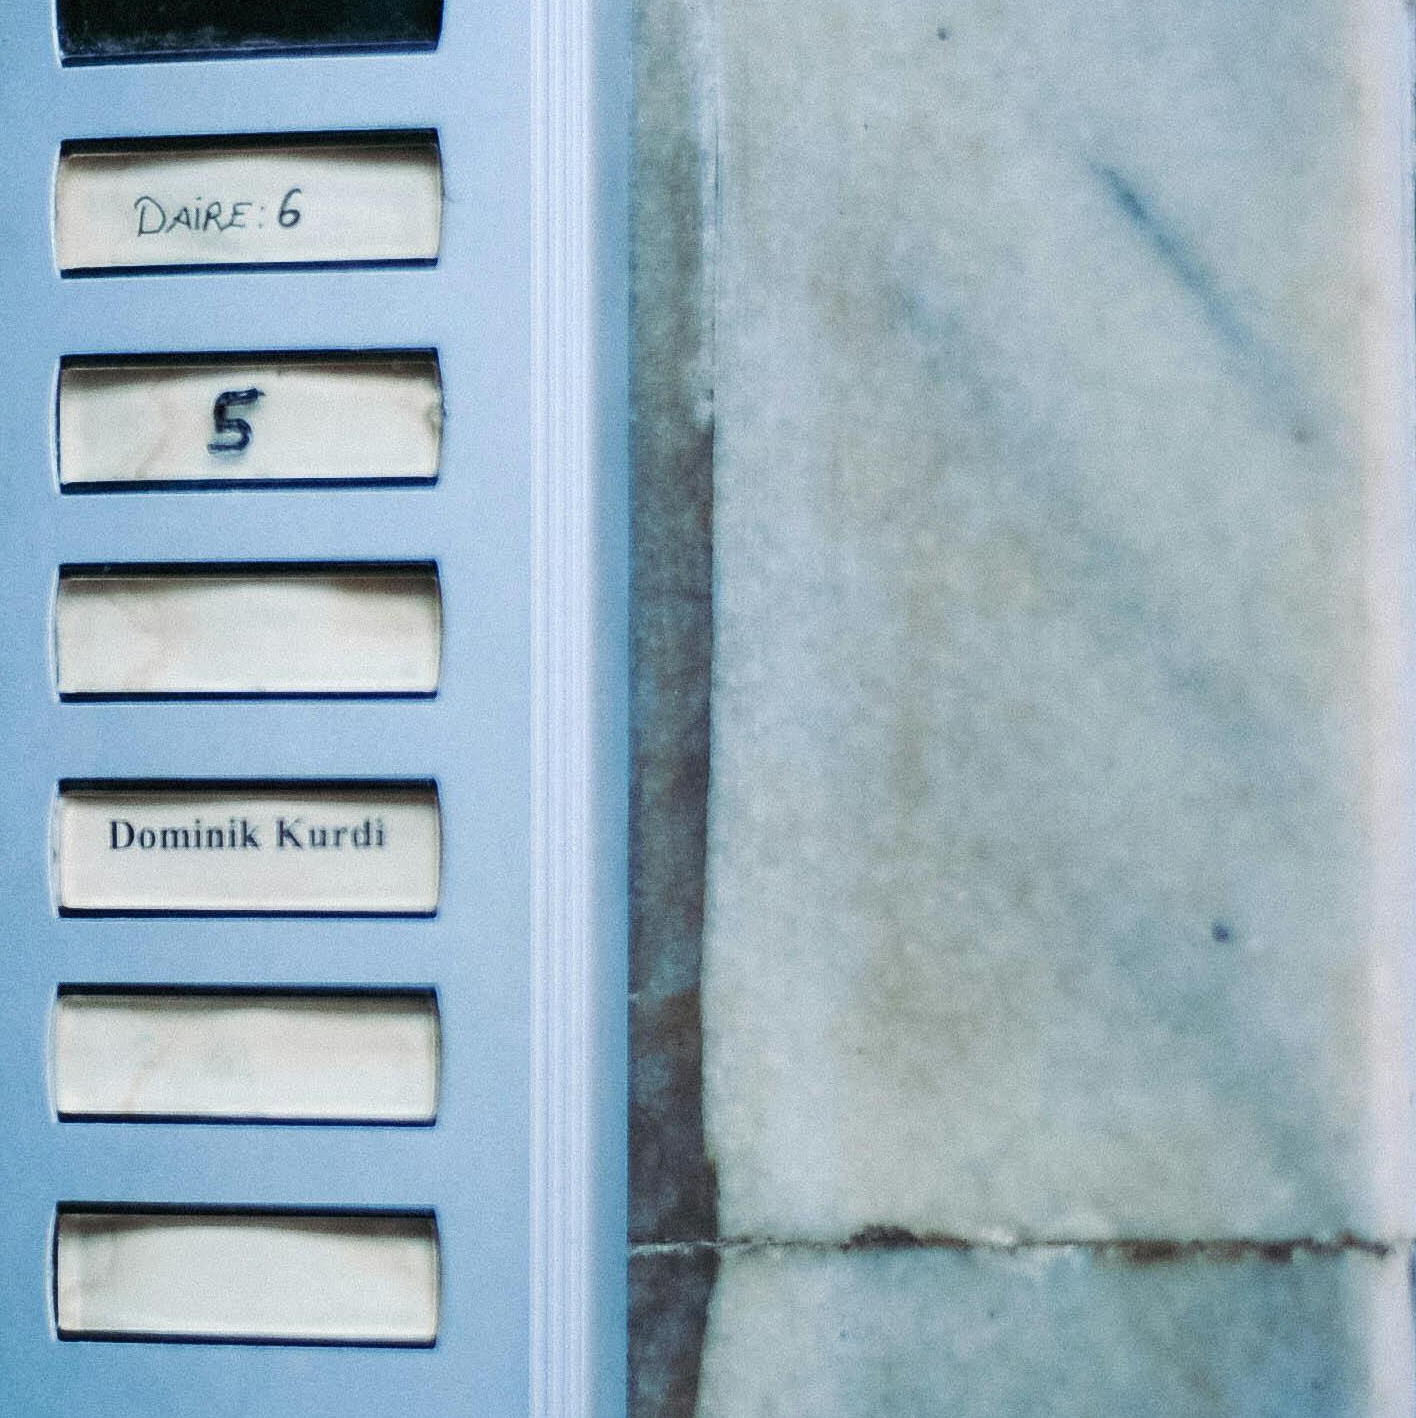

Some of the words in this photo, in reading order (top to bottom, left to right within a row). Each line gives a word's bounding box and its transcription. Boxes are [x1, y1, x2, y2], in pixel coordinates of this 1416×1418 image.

[277, 187, 303, 229] 6
[206, 387, 266, 454] 5
[109, 818, 261, 851] Dominik
[275, 818, 386, 850] Kurdi
